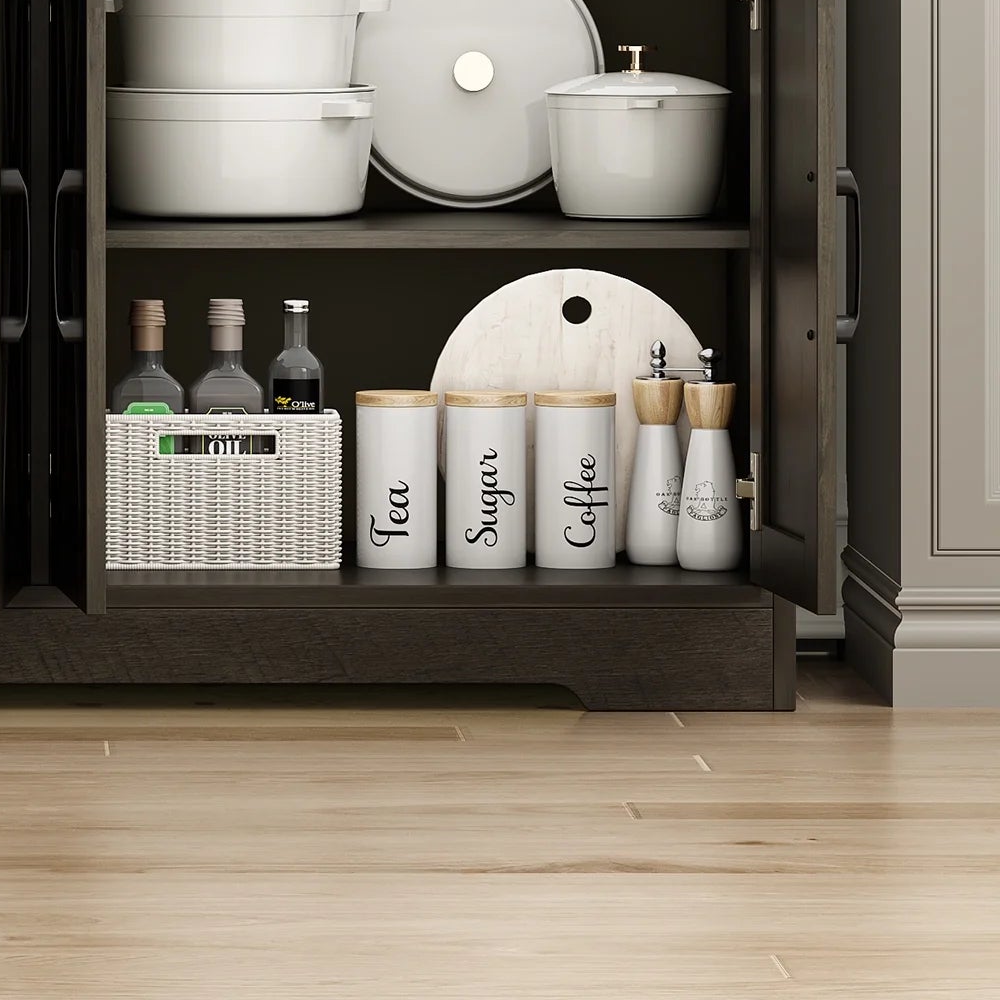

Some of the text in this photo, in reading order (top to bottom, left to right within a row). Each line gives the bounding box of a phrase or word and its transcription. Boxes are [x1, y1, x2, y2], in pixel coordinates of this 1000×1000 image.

[208, 440, 247, 455] OIL
[369, 479, 410, 548] Tea
[464, 447, 516, 548] Sugar
[563, 453, 609, 548] Coffee
